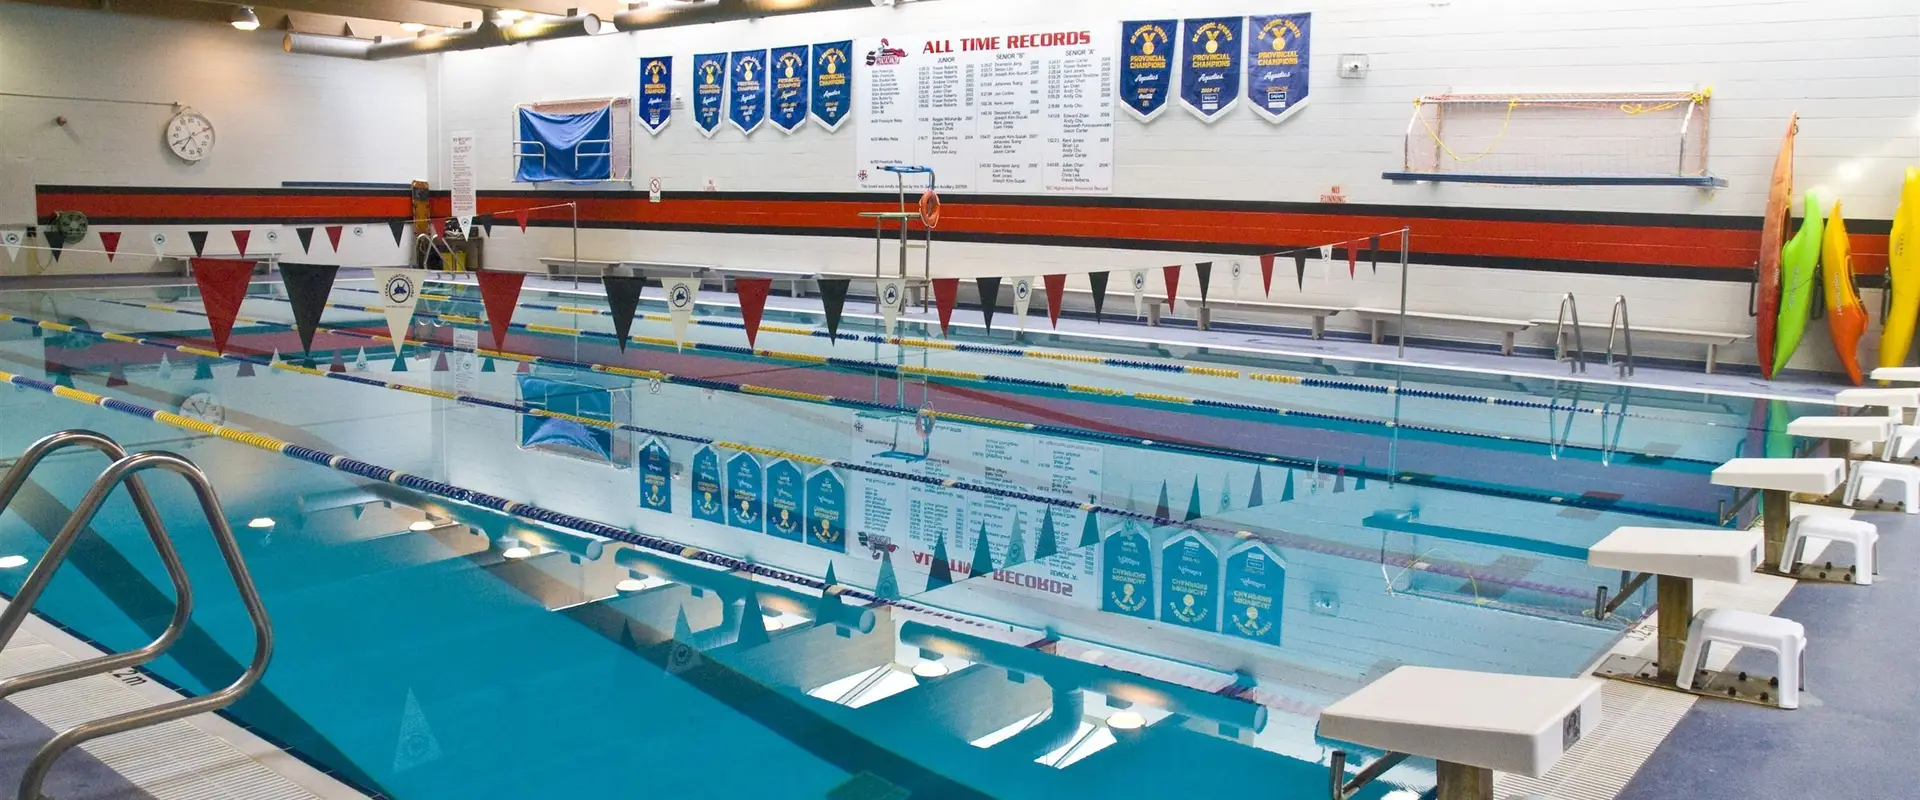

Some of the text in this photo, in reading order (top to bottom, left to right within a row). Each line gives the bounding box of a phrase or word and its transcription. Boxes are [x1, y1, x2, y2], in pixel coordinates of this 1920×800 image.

[922, 31, 1091, 55] ALL TIME RECORDS
[1192, 53, 1231, 61] PROVINCIAL
[1257, 50, 1298, 59] PROVINCIAL
[1130, 61, 1167, 69] CHAMPIONS
[1192, 60, 1231, 68] CHAMPIONS
[1257, 58, 1298, 66] CHAMPIONS
